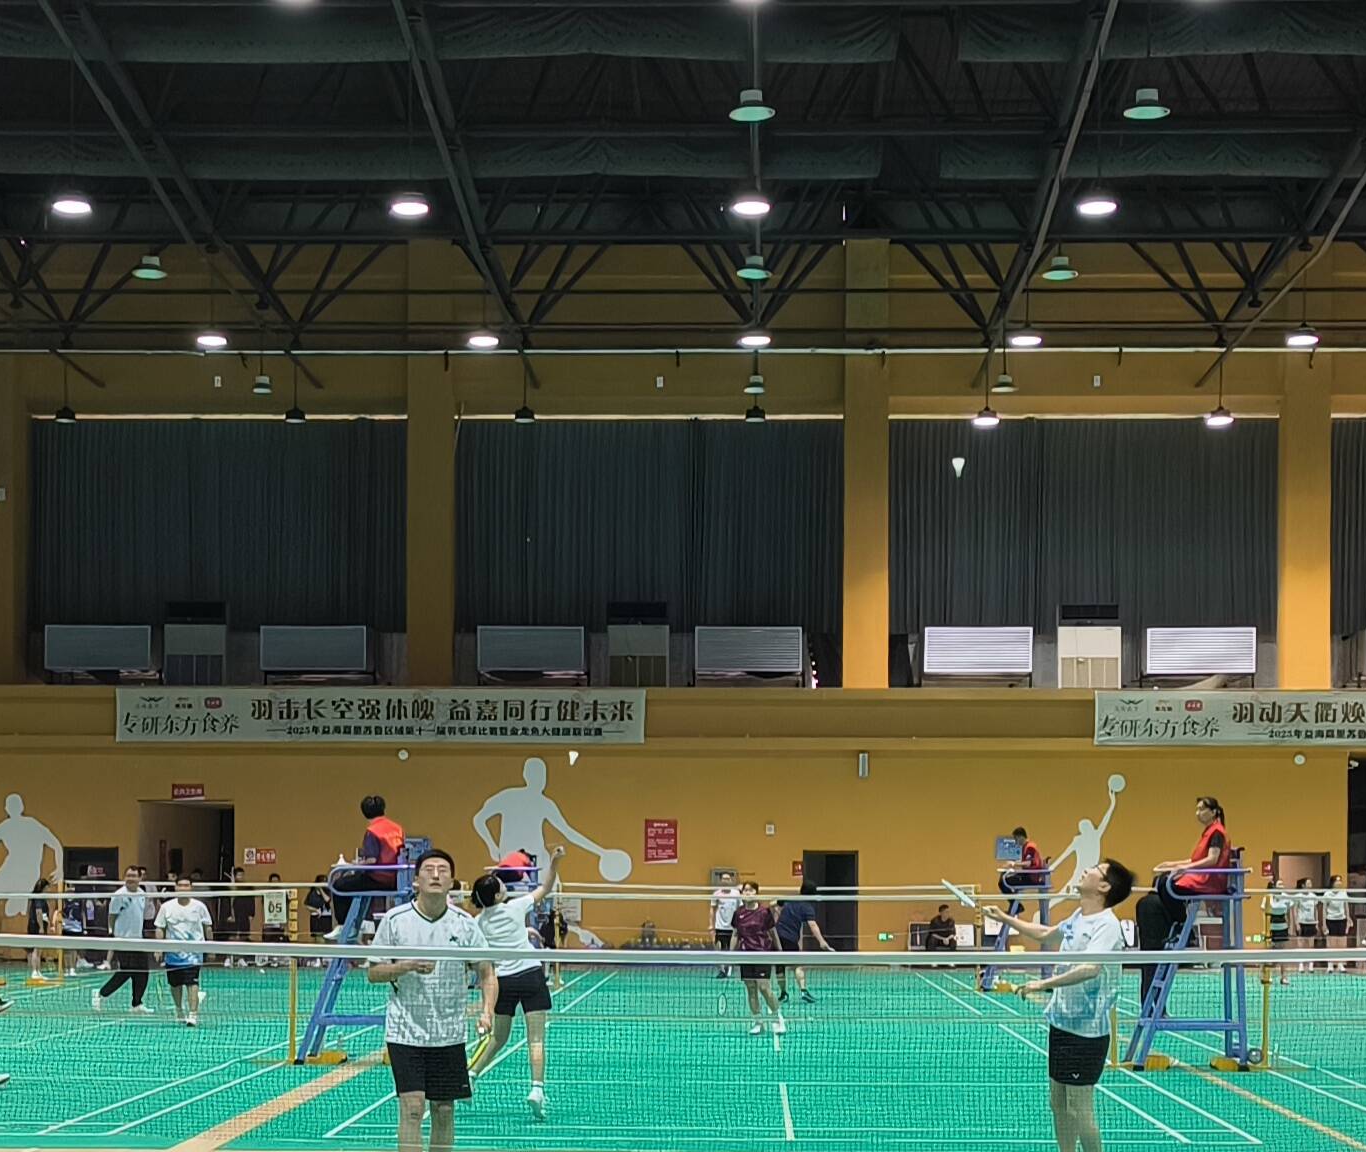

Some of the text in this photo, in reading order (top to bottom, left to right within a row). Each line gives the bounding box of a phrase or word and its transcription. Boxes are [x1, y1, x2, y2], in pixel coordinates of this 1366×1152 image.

[250, 697, 436, 721] 羽击长空强体魄
[447, 698, 635, 721] 益嘉同行健未来
